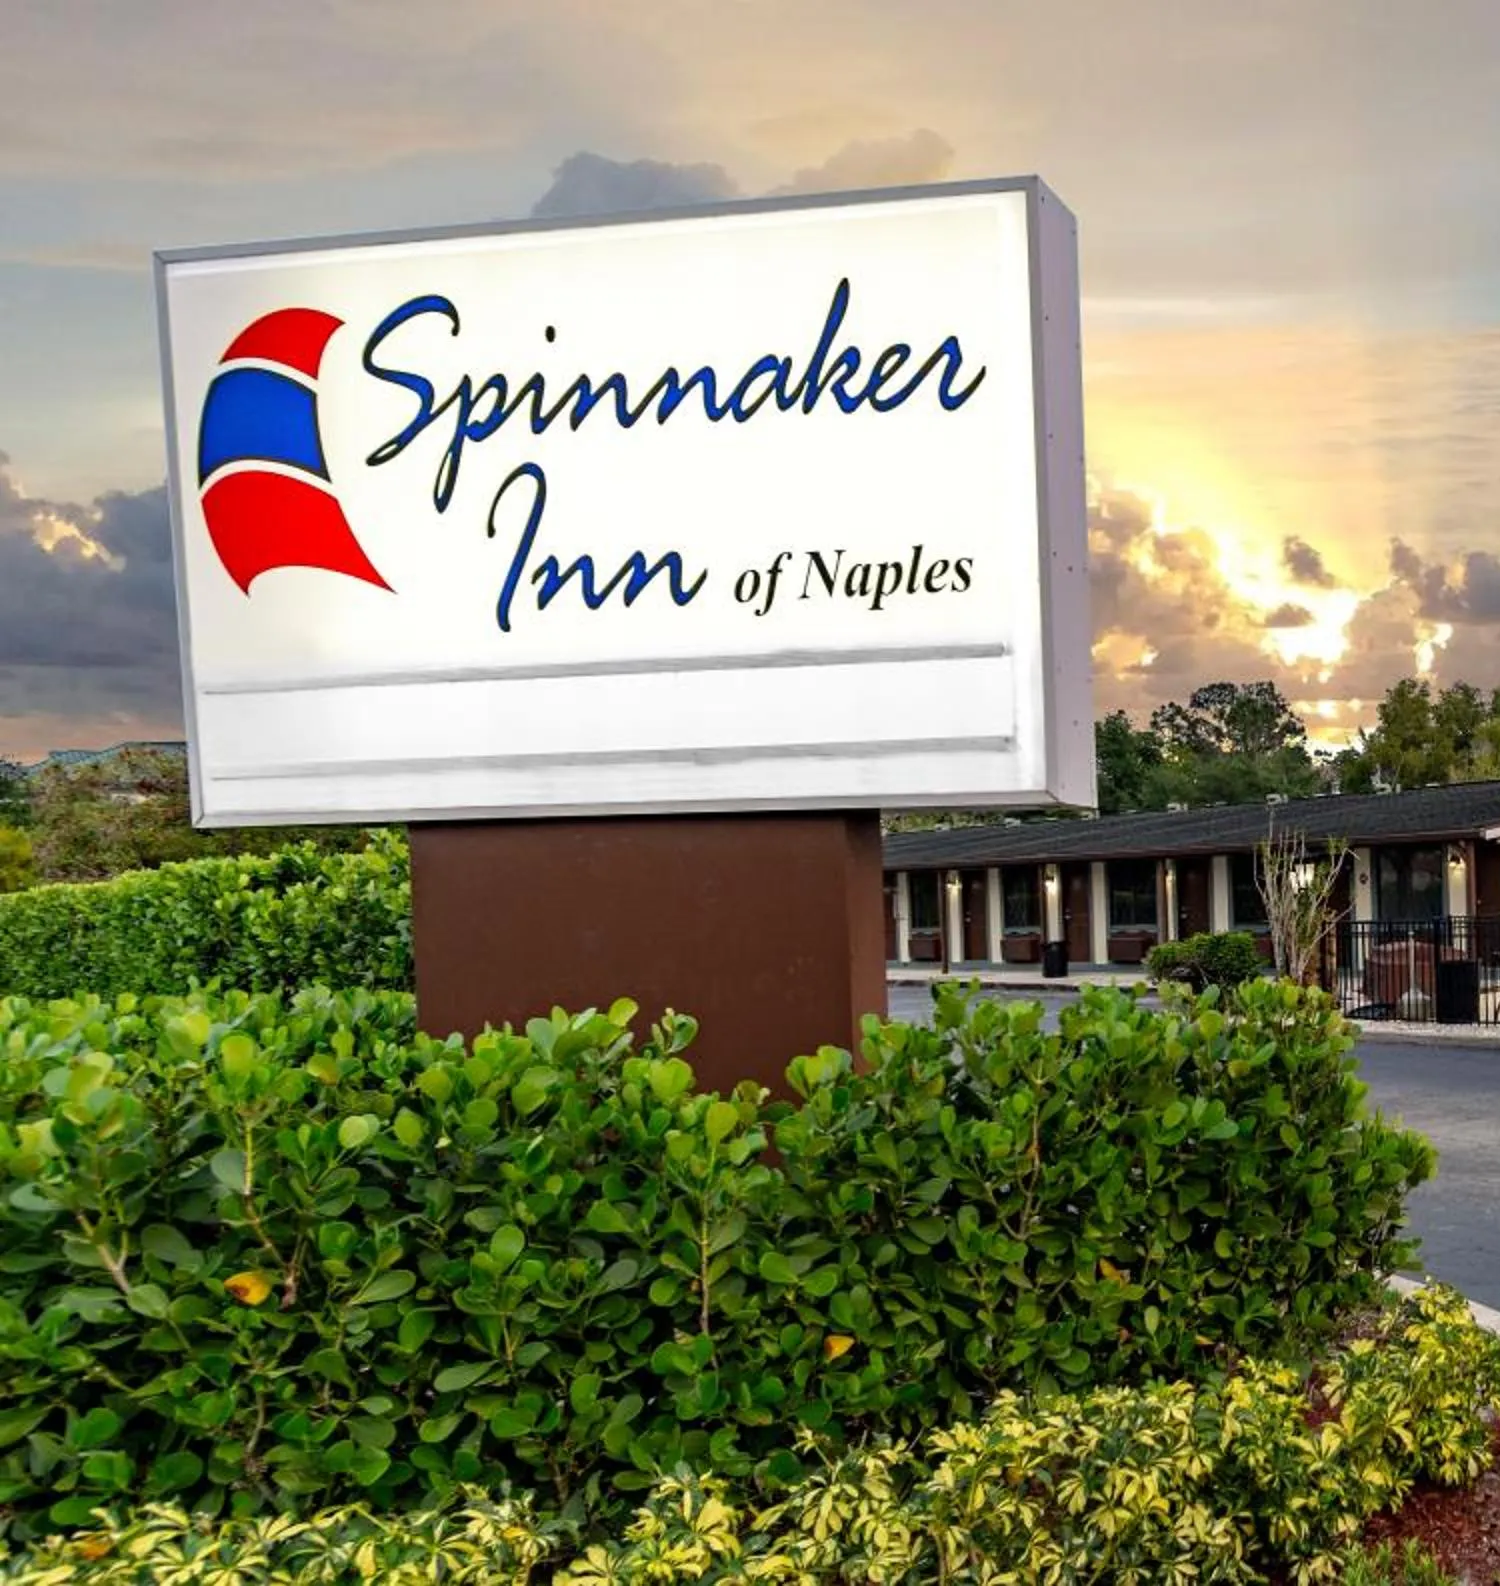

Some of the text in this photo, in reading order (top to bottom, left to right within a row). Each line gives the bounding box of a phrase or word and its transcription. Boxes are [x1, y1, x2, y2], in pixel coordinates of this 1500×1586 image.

[362, 277, 987, 514] Spinnaker
[486, 461, 708, 633] Inn
[734, 544, 974, 617] of Naples
